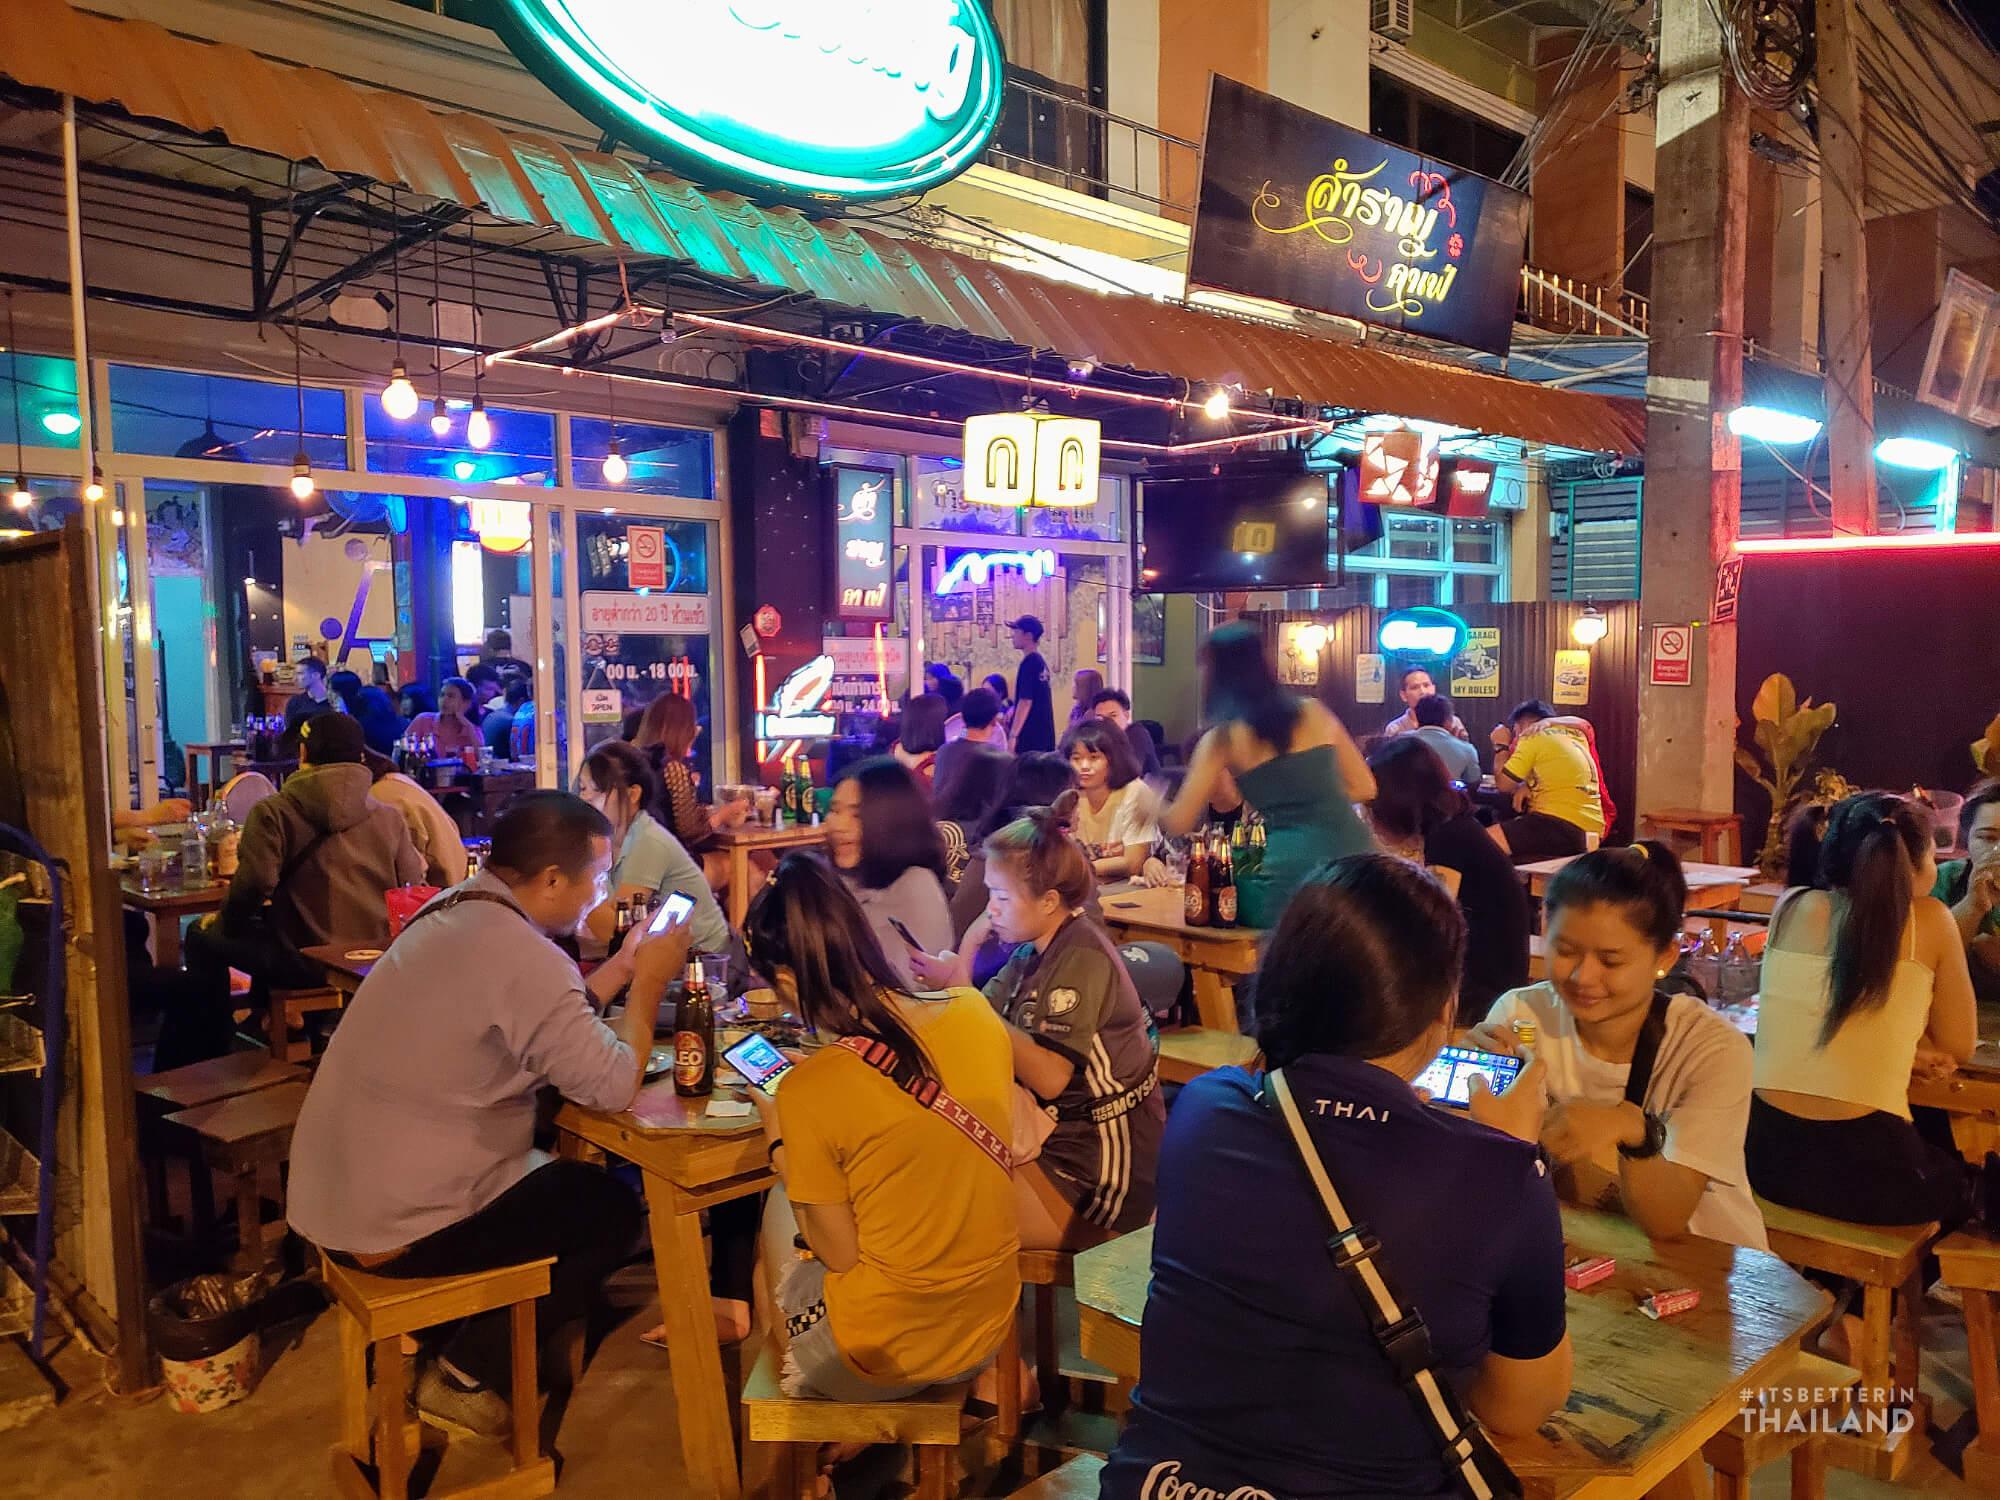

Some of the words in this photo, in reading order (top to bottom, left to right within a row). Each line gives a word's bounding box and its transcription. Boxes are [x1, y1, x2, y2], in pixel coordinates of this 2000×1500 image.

[1252, 158, 1438, 257] สำราญ
[645, 606, 658, 622] 20
[660, 602, 668, 622] ปี
[1454, 685, 1466, 694] MY
[1468, 685, 1496, 695] RULES!
